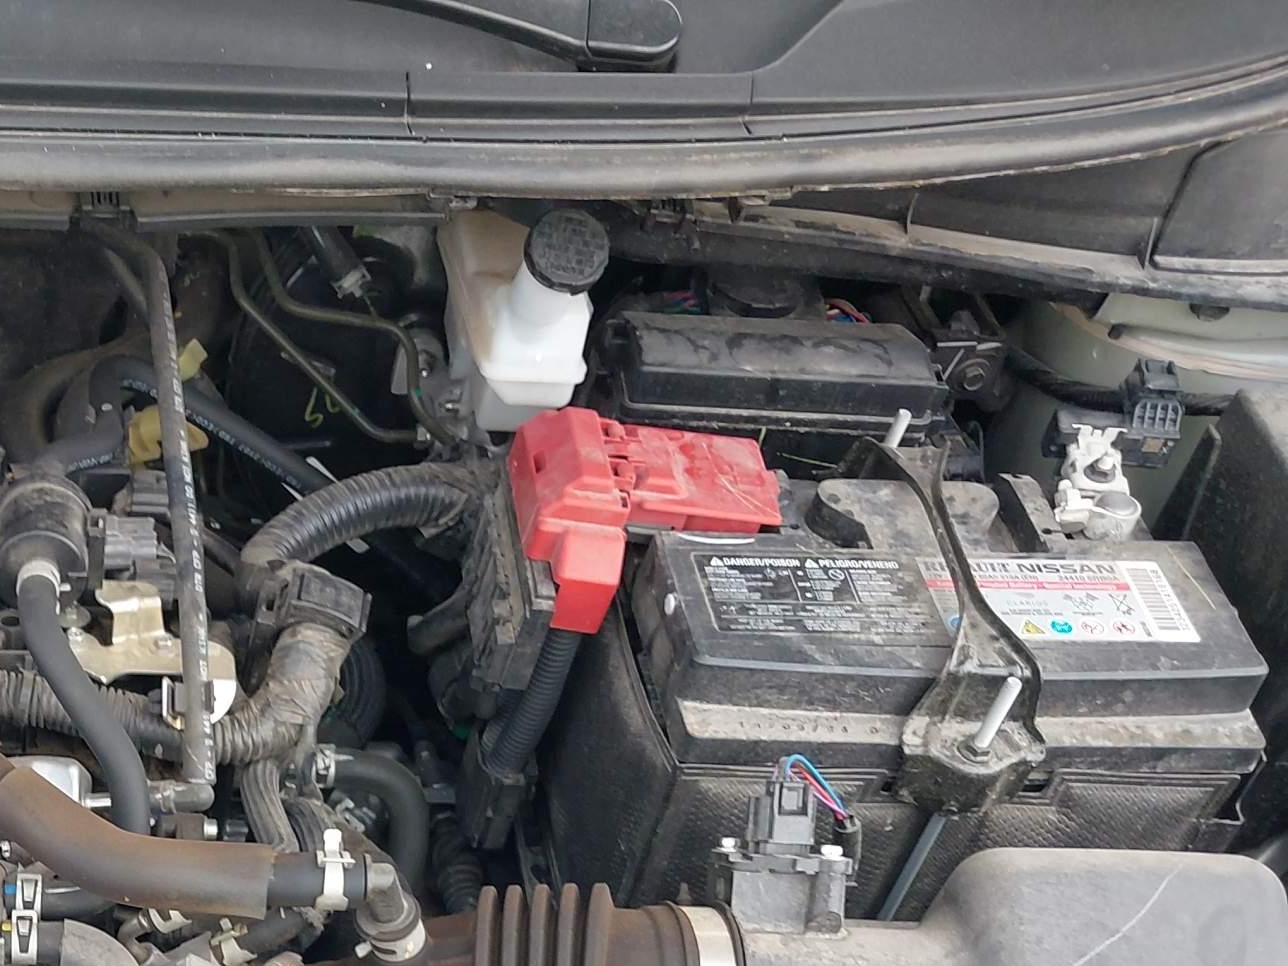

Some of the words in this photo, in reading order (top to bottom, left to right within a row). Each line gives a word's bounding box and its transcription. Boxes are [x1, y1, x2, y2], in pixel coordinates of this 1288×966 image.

[723, 557, 800, 567] DANGER/POISON
[818, 559, 899, 569] PELIGRO/VENENO
[1017, 563, 1116, 575] NISSAN
